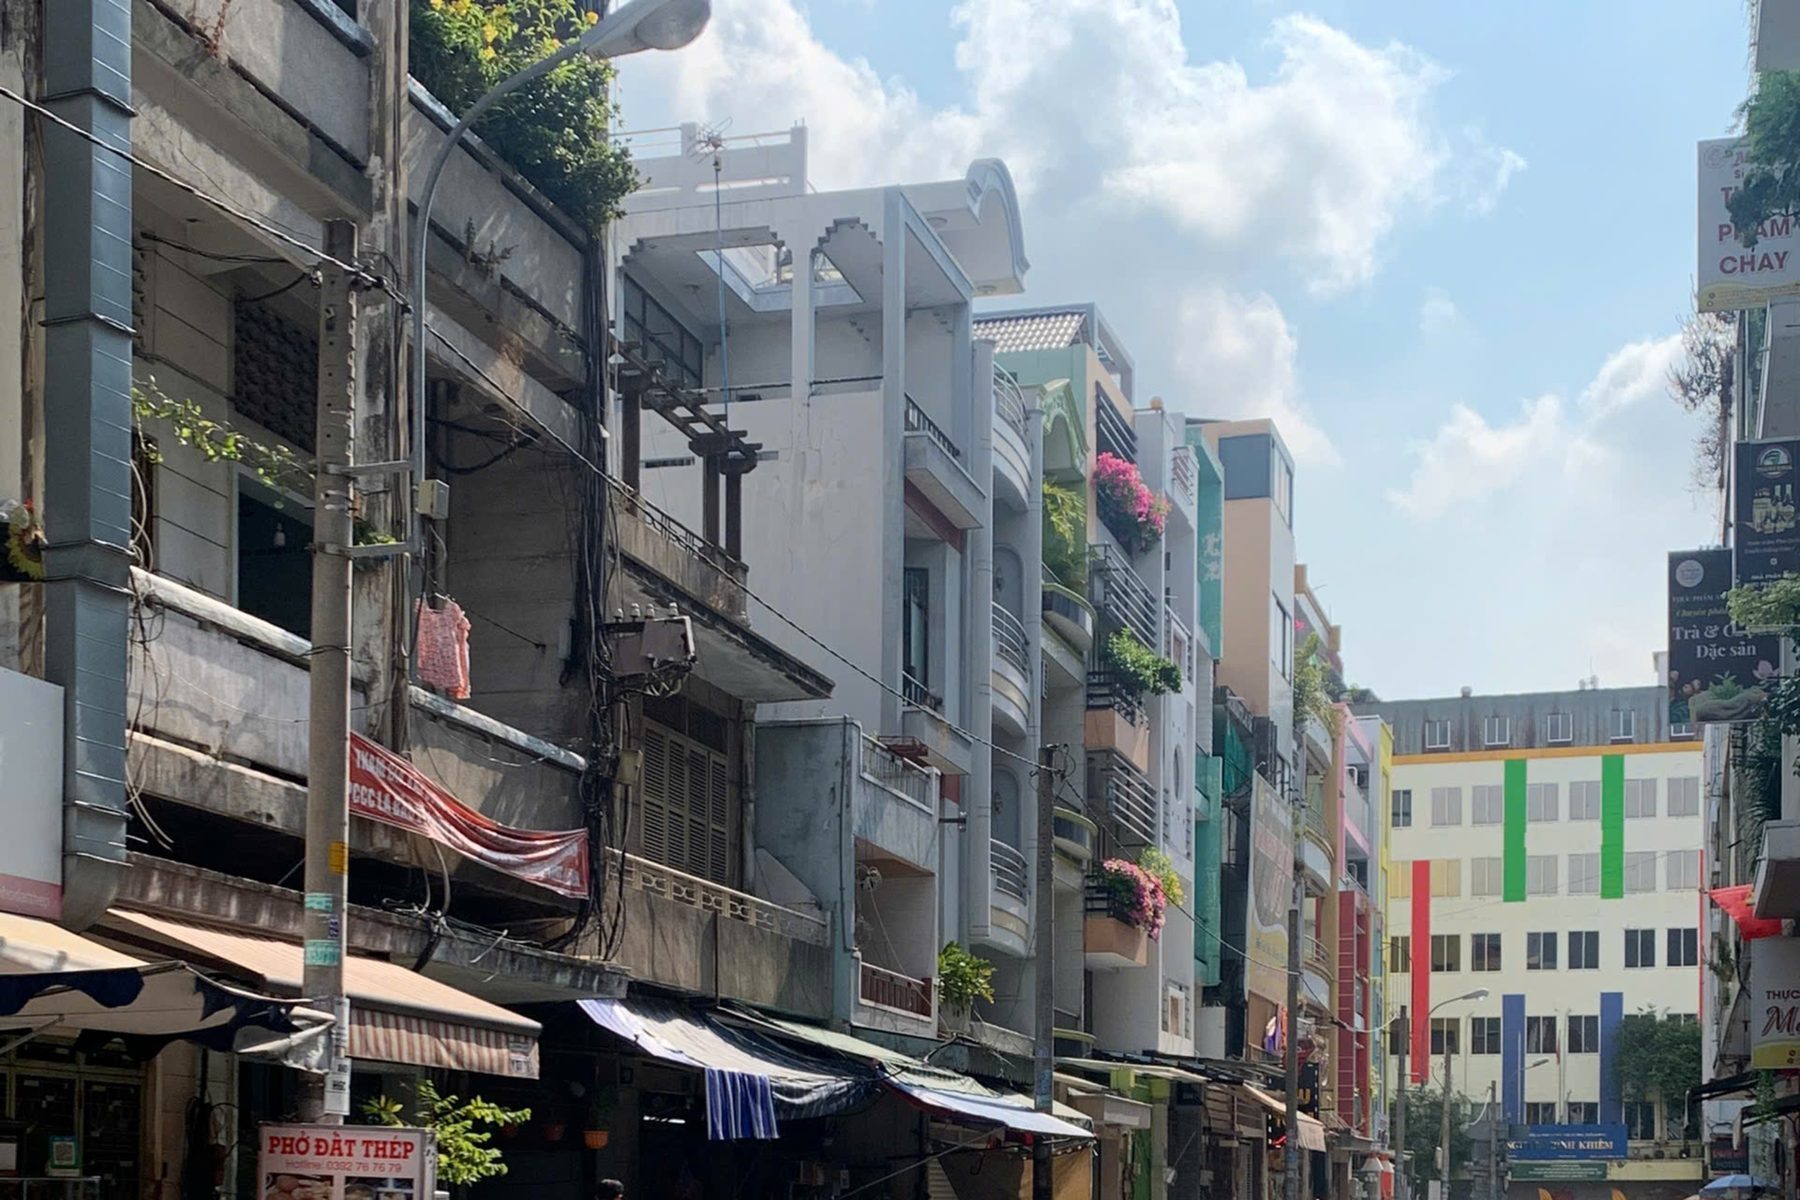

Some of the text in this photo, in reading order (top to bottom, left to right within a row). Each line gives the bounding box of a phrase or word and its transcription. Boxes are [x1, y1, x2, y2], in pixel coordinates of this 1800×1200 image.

[1719, 250, 1788, 274] CHAY
[1672, 624, 1700, 640] Trà
[1704, 624, 1720, 638] &
[1729, 641, 1757, 656] sản
[268, 1131, 310, 1156] PHỞ
[361, 1135, 415, 1160] THÉP
